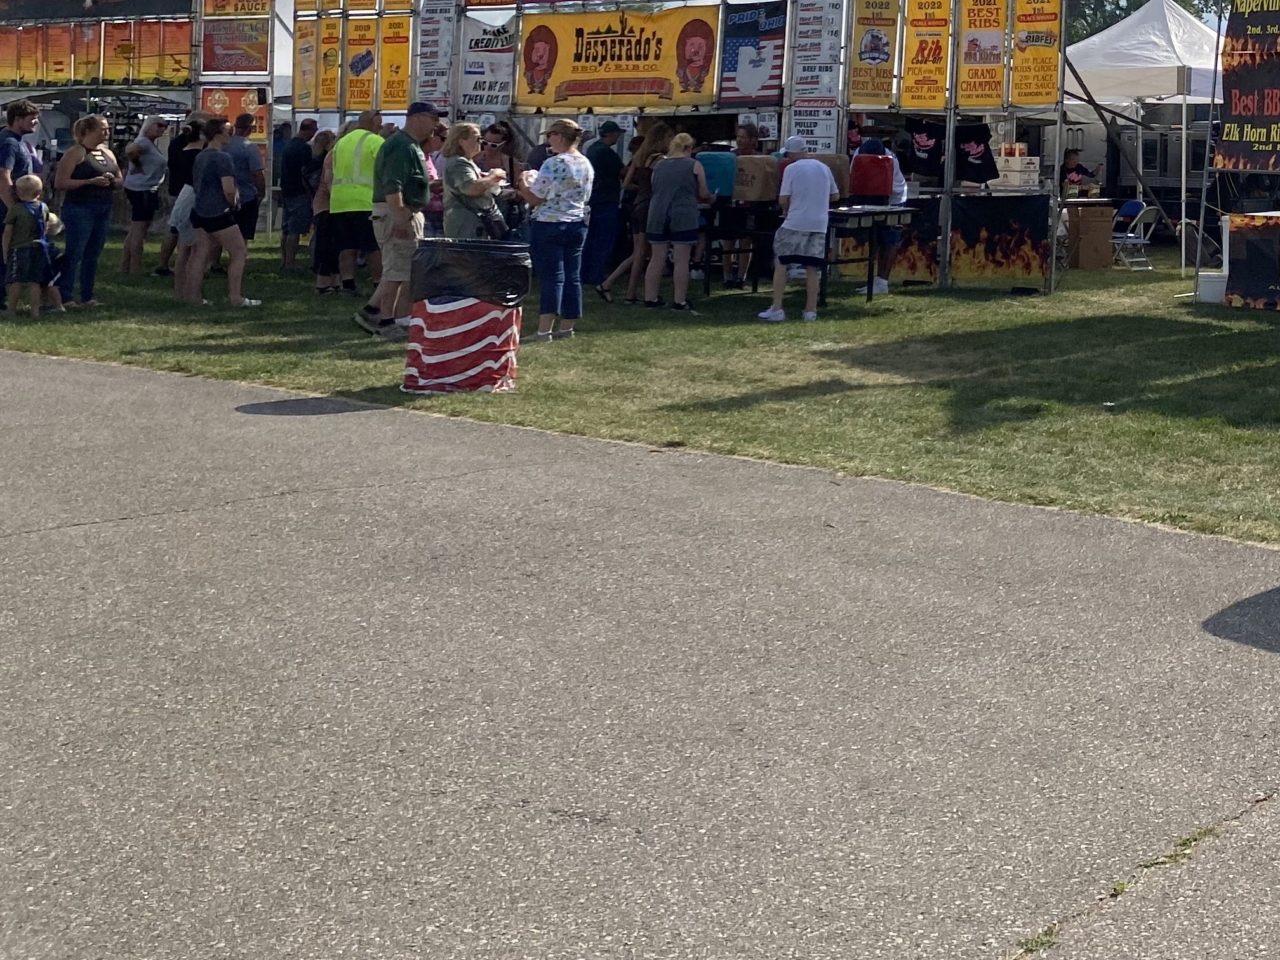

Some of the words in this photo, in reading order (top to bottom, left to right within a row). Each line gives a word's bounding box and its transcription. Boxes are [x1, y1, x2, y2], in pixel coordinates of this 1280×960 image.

[233, 2, 267, 12] SAUCE
[864, 1, 890, 10] 2022
[917, 1, 943, 10] 2022
[967, 8, 1002, 18] BEST
[968, 18, 1000, 29] RIBS
[573, 27, 663, 67] Desperado's
[1014, 65, 1032, 73] KIDS
[1034, 64, 1058, 72] CHOICE
[967, 68, 997, 80] GRAND
[350, 79, 372, 88] BEST
[386, 80, 405, 89] BEST
[960, 80, 1002, 92] CHAMPION
[1015, 82, 1034, 90] BEST
[1035, 81, 1056, 90] SAUCE
[350, 89, 370, 99] RIBS
[384, 90, 406, 98] SAUCE
[927, 85, 944, 94] RIBS
[1231, 89, 1258, 116] Best
[1222, 123, 1240, 141] Elk
[1243, 124, 1267, 143] Horn
